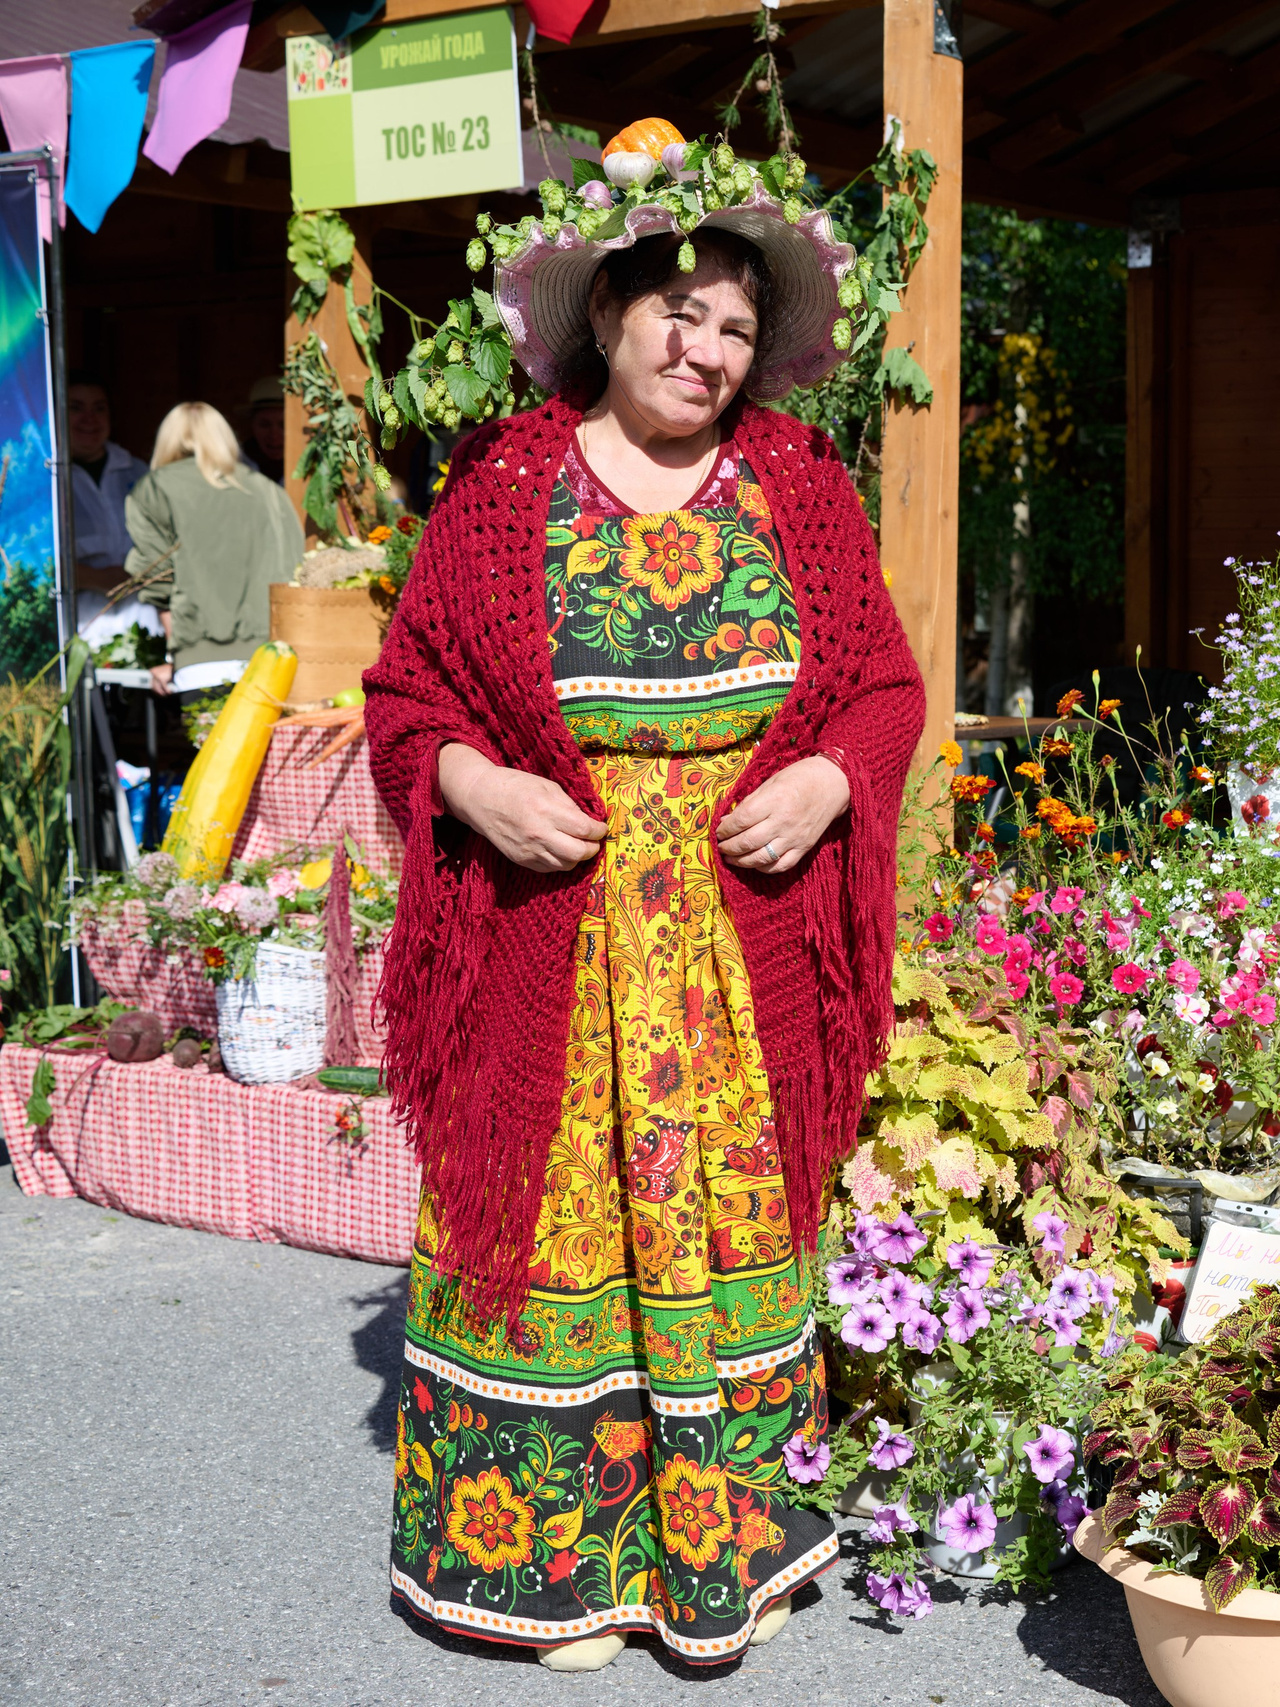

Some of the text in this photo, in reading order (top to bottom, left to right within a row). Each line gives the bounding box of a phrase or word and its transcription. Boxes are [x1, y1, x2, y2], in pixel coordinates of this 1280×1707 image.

[380, 30, 485, 70] УРОЖАЙ ГОДА
[382, 114, 490, 161] ТОС № 23
[1206, 1231, 1254, 1261] Мы
